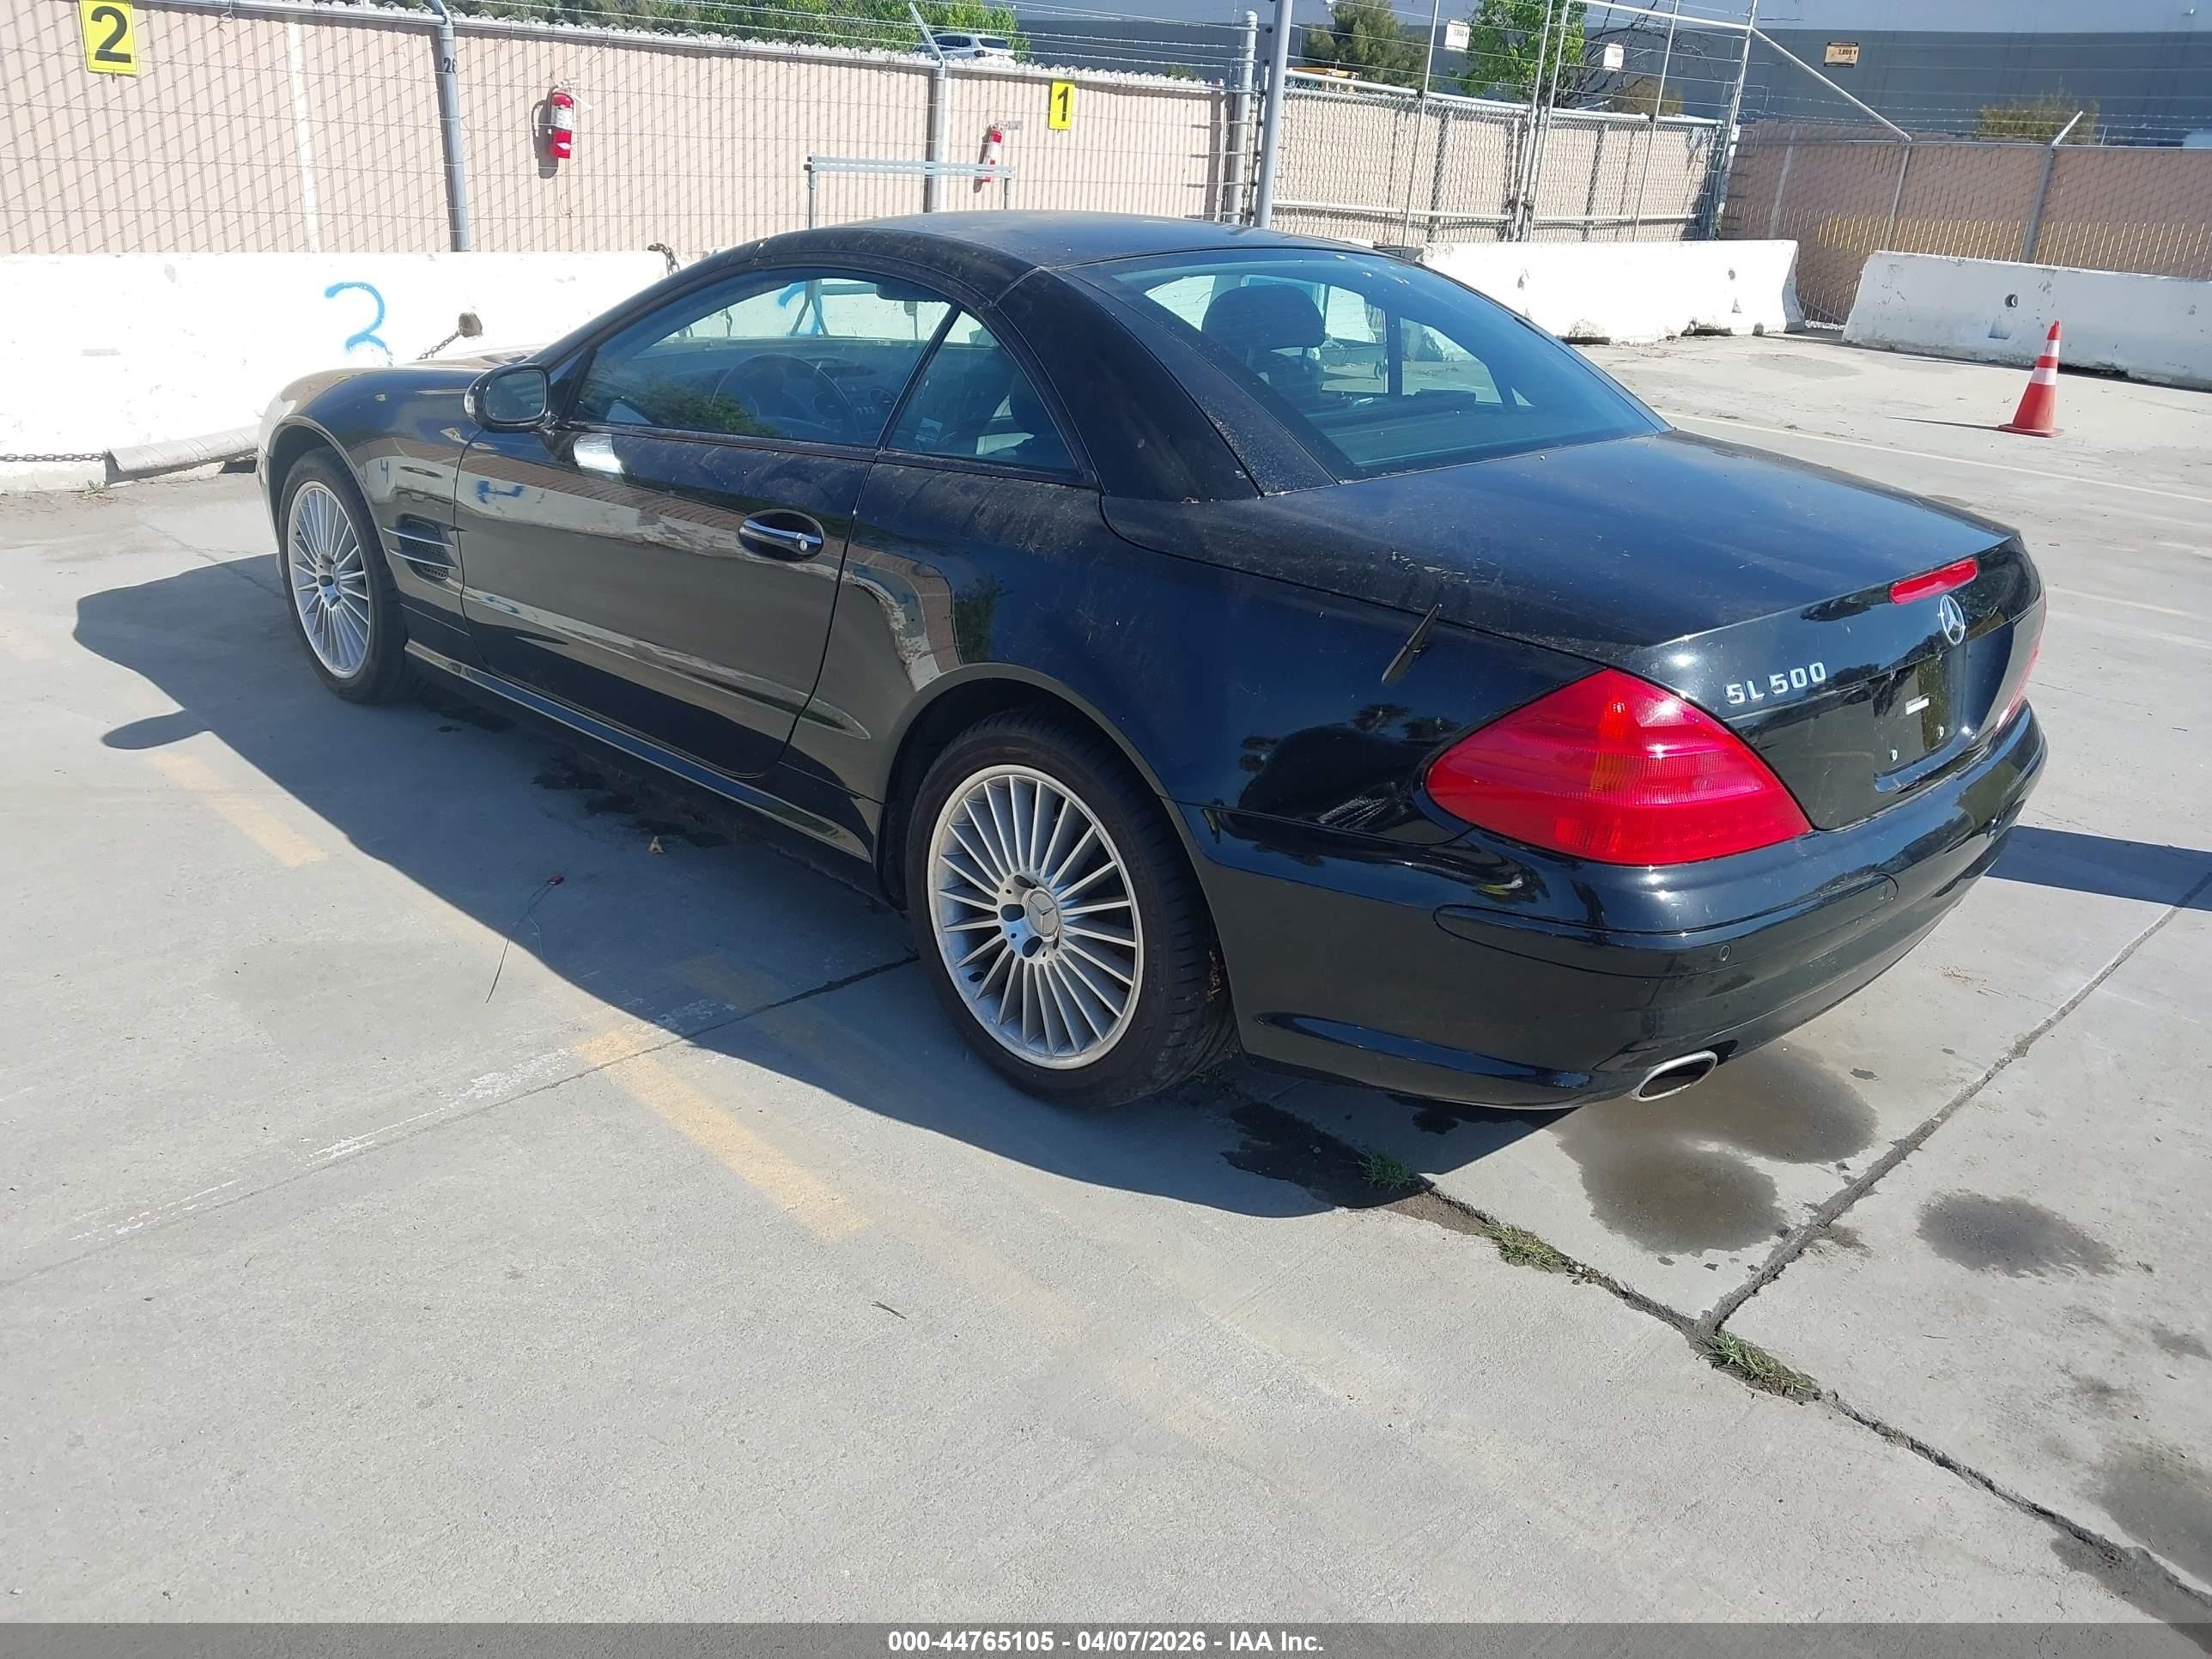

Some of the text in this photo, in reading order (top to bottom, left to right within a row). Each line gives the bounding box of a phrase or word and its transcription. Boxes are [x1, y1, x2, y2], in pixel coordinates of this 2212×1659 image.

[91, 5, 131, 64] 2
[1057, 86, 1070, 123] 1
[324, 281, 392, 362] 2
[1724, 661, 1826, 705] SL 500
